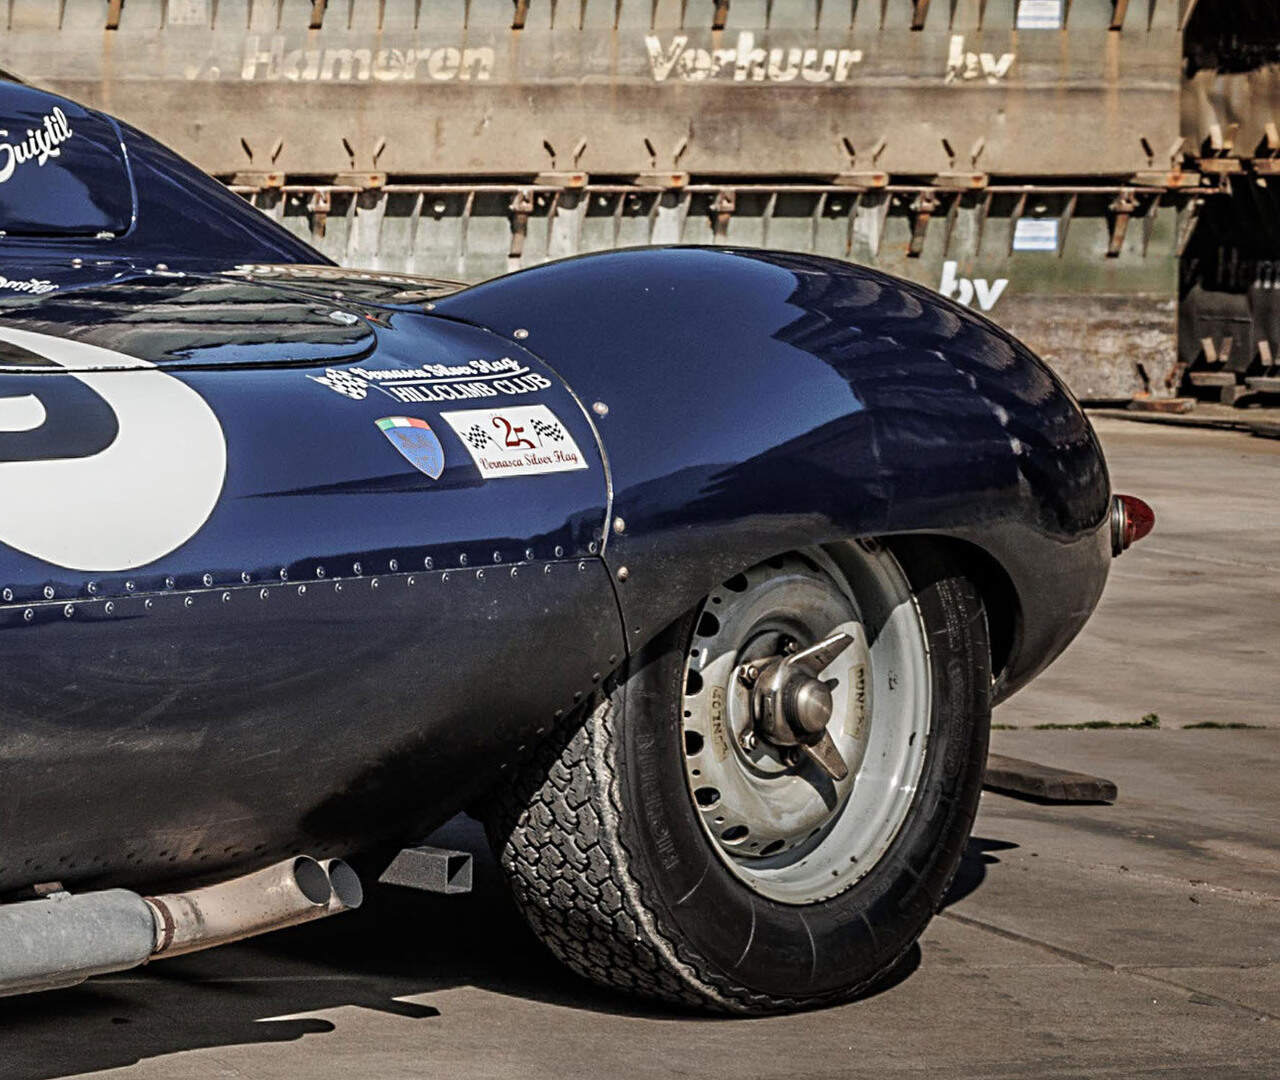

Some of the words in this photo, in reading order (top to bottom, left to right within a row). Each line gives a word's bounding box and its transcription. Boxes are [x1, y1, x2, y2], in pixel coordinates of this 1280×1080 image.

[240, 34, 496, 81] Hameren
[644, 31, 864, 83] Verhuur
[945, 34, 1016, 85] bv
[940, 260, 1009, 312] bv
[390, 383, 498, 403] HILLCLIMB
[492, 372, 553, 396] CLUB
[480, 457, 523, 470] Vernasca
[523, 453, 552, 467] Silver
